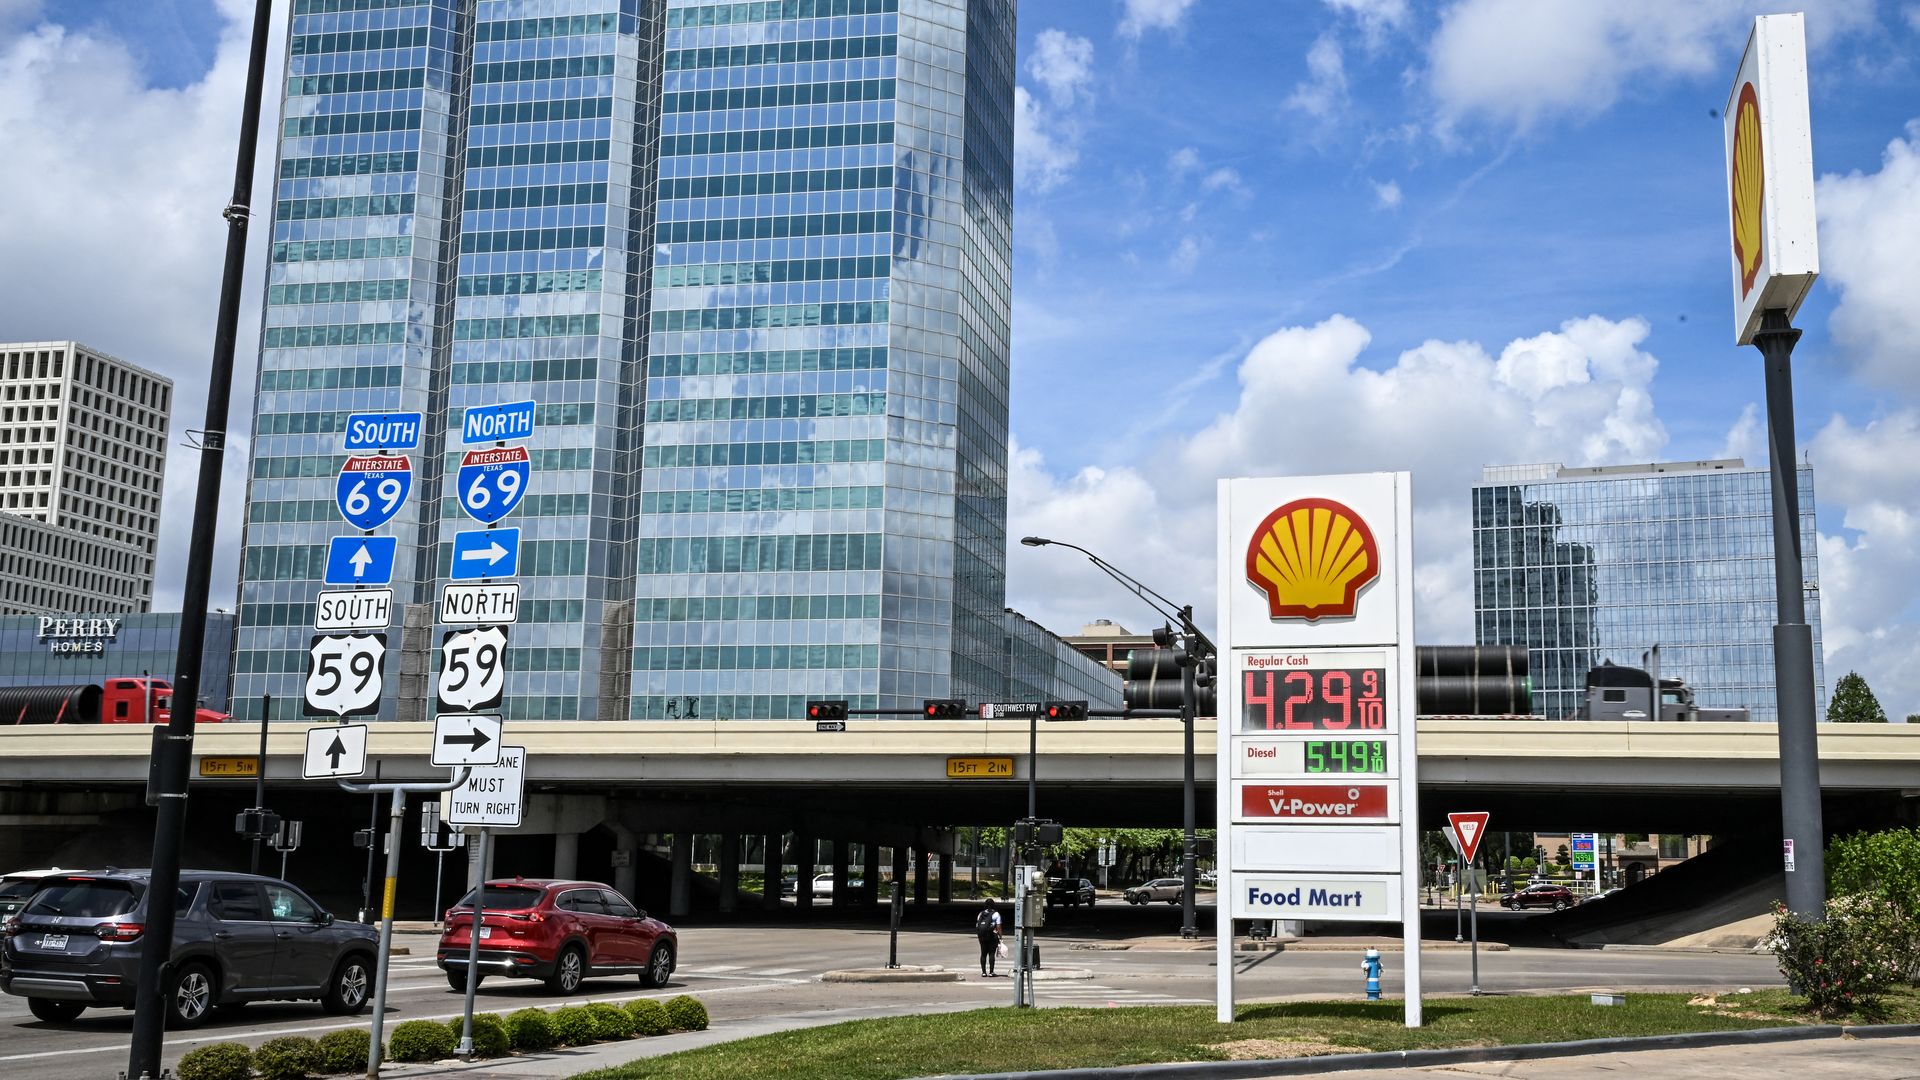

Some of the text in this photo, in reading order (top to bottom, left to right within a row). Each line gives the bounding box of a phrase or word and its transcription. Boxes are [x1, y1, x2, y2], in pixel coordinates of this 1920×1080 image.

[350, 420, 416, 444] SOUTH
[466, 410, 530, 437] NORTH
[351, 460, 403, 470] INTERSTATE
[470, 451, 521, 464] INTERSTATE
[345, 478, 402, 516] 69
[467, 470, 521, 510] 69
[320, 598, 388, 621] SOUTH
[446, 592, 515, 615] NORTH
[36, 616, 120, 637] PERRY
[50, 642, 102, 652] HOMES
[446, 644, 498, 692] 59
[1248, 654, 1308, 668] Regular Cash
[315, 651, 375, 696] 59
[994, 704, 1025, 712] SOUTHWEST
[1026, 704, 1037, 712] FWY
[1246, 671, 1351, 730] 4.29
[1247, 747, 1276, 758] Diesel
[1308, 742, 1368, 773] 5.49
[206, 762, 253, 772] 15FT 5IN
[494, 756, 519, 768] ANE
[953, 762, 1007, 772] 15FT 2IN
[468, 778, 504, 792] MUST
[455, 802, 516, 814] TURN RIGHT
[1268, 798, 1356, 815] V-Power
[1249, 887, 1362, 907] Food Mart
